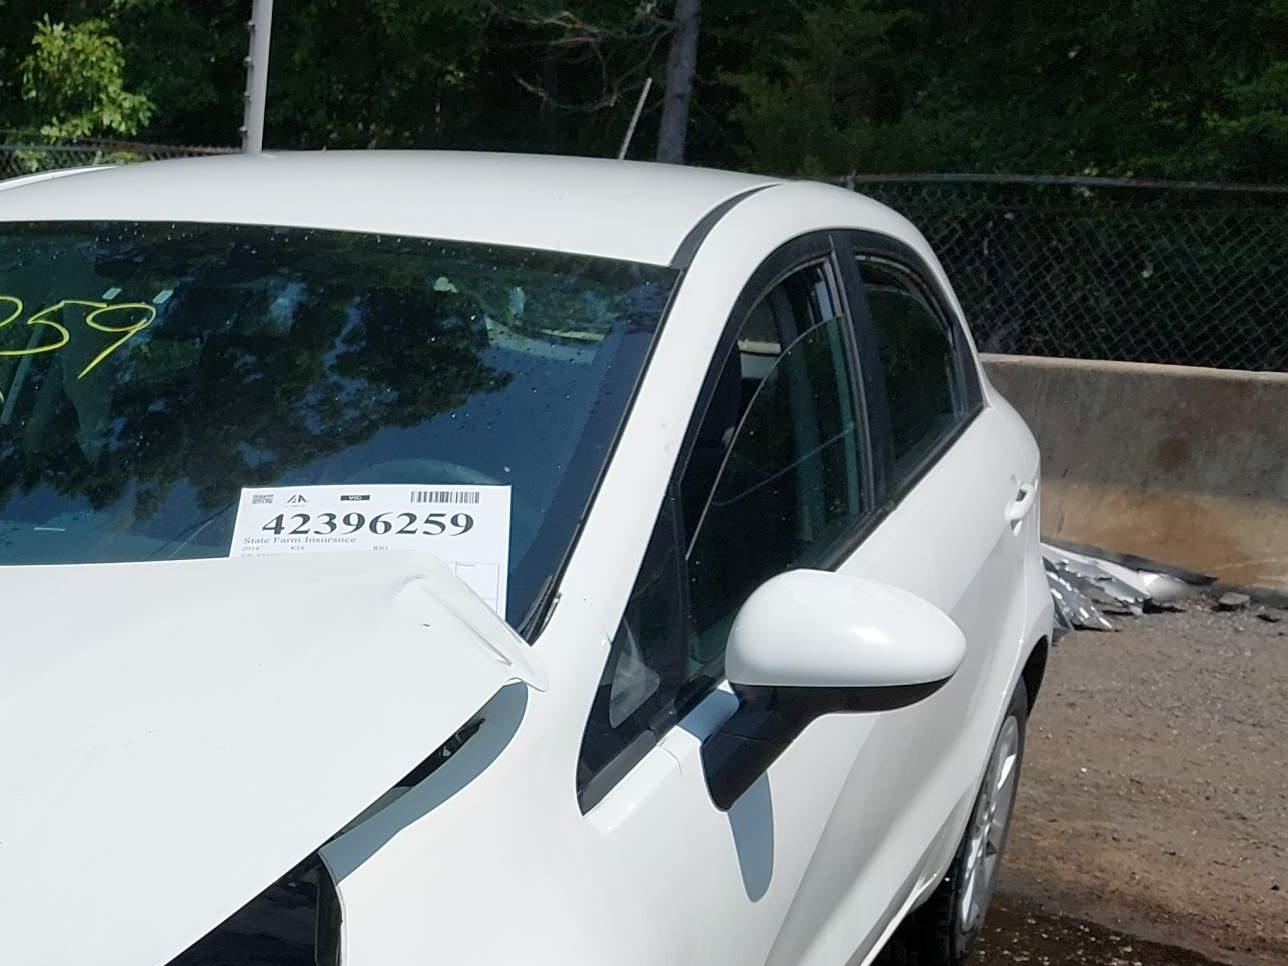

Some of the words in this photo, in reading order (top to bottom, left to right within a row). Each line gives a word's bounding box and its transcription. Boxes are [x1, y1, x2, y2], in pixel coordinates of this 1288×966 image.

[261, 512, 475, 537] 42396259
[242, 536, 271, 544] State
[273, 536, 302, 544] Farm
[305, 536, 357, 544] Insurance
